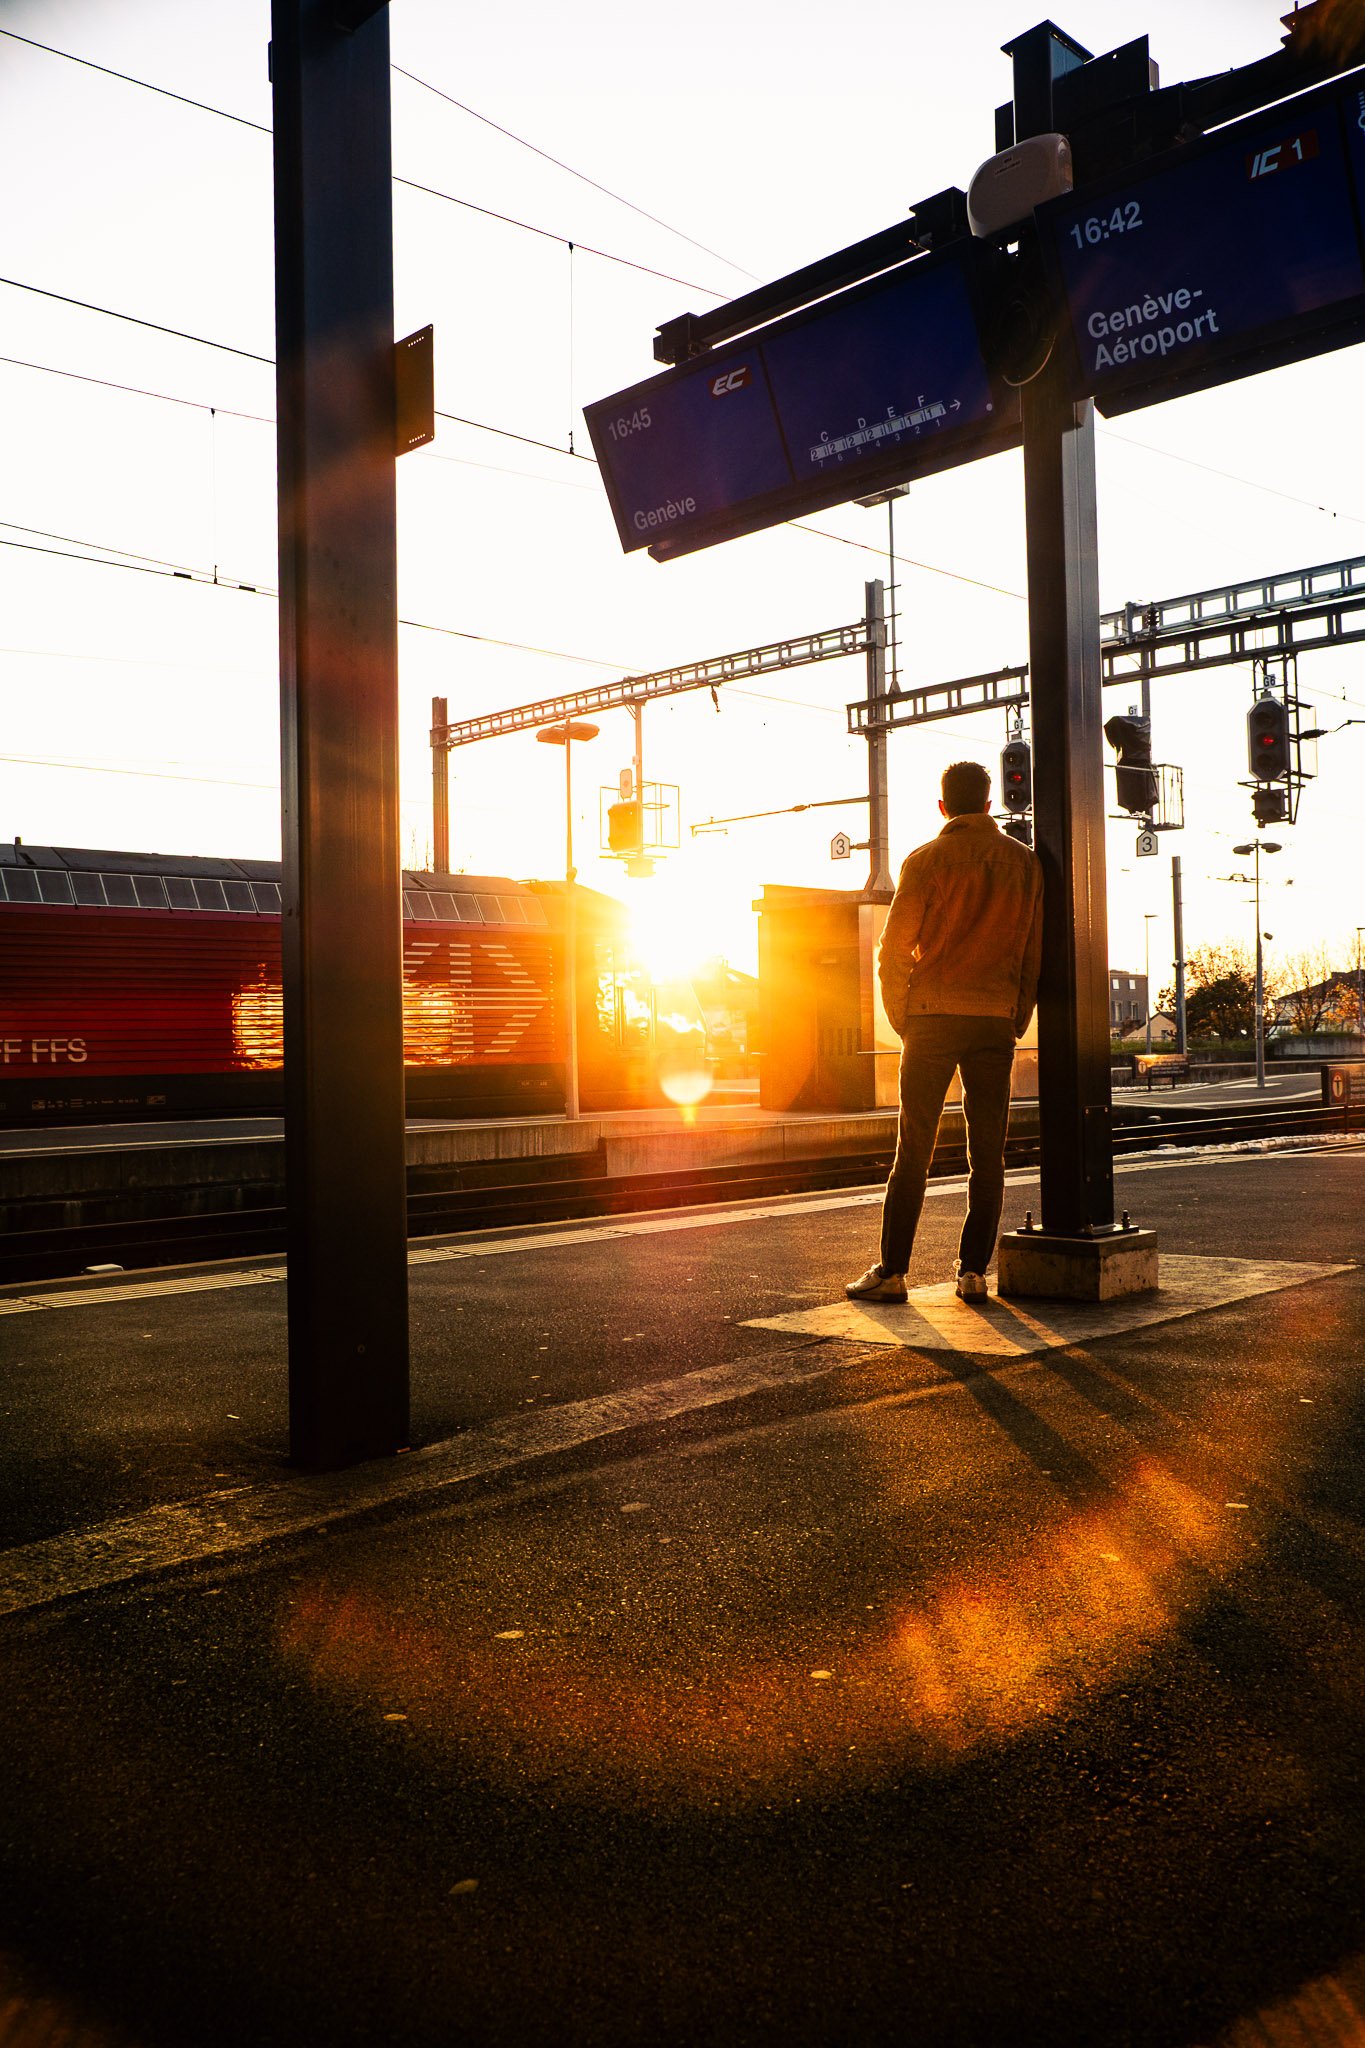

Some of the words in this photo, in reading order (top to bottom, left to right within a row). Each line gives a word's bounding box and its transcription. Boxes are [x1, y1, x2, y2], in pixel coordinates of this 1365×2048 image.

[1250, 145, 1282, 179] IC
[1291, 138, 1303, 161] 1
[1070, 201, 1143, 249] 16:42
[1087, 288, 1203, 338] Genève-
[1095, 308, 1220, 371] Aéroport
[711, 367, 747, 396] EC
[608, 407, 652, 441] 16:45
[820, 431, 829, 442] C
[857, 417, 866, 429] D
[886, 406, 896, 418] E
[917, 395, 925, 407] F
[811, 450, 818, 459] 2
[829, 443, 837, 453] 2
[848, 436, 855, 446] 2
[867, 429, 874, 439] 2
[633, 497, 697, 530] Genève
[836, 838, 845, 855] 3
[1142, 836, 1153, 853] 3
[0, 1039, 22, 1064] F
[31, 1038, 88, 1063] FFS
